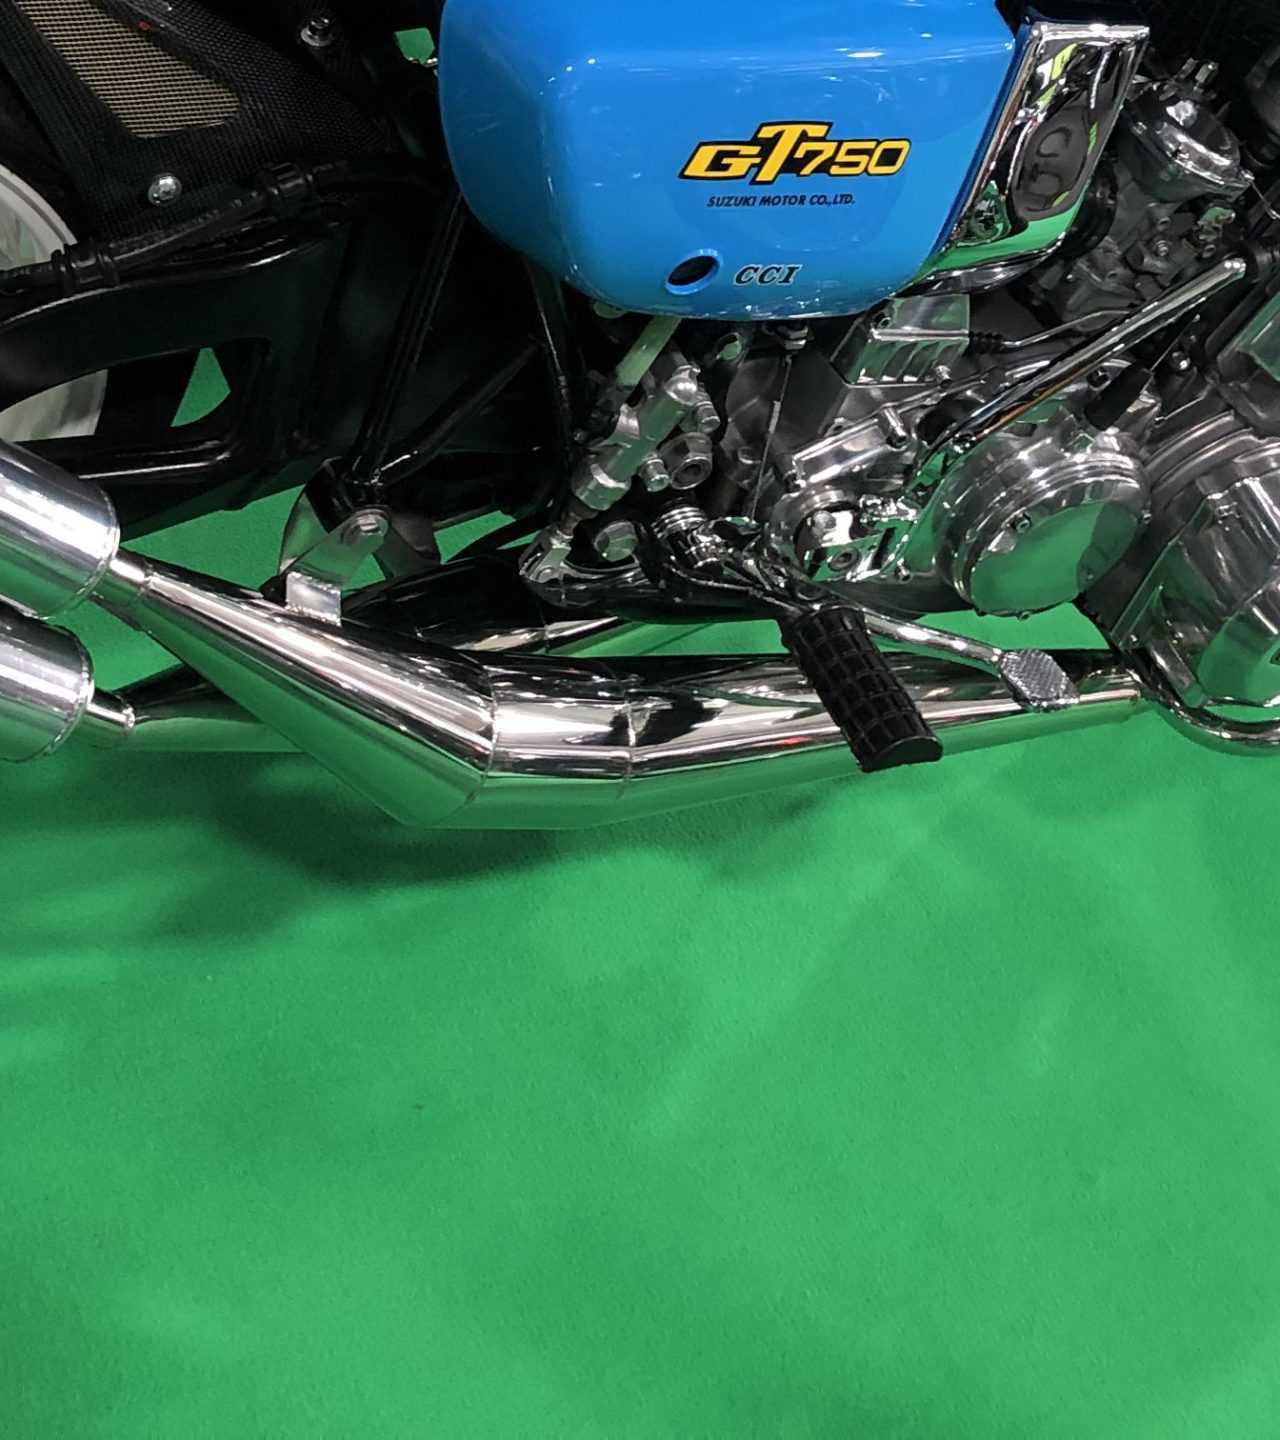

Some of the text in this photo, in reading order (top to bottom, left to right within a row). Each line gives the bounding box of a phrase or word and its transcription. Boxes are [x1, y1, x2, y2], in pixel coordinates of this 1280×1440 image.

[677, 119, 912, 186] GT750
[706, 194, 757, 208] SUZUKI
[758, 194, 806, 207] MOTOR
[732, 262, 802, 287] CCI
